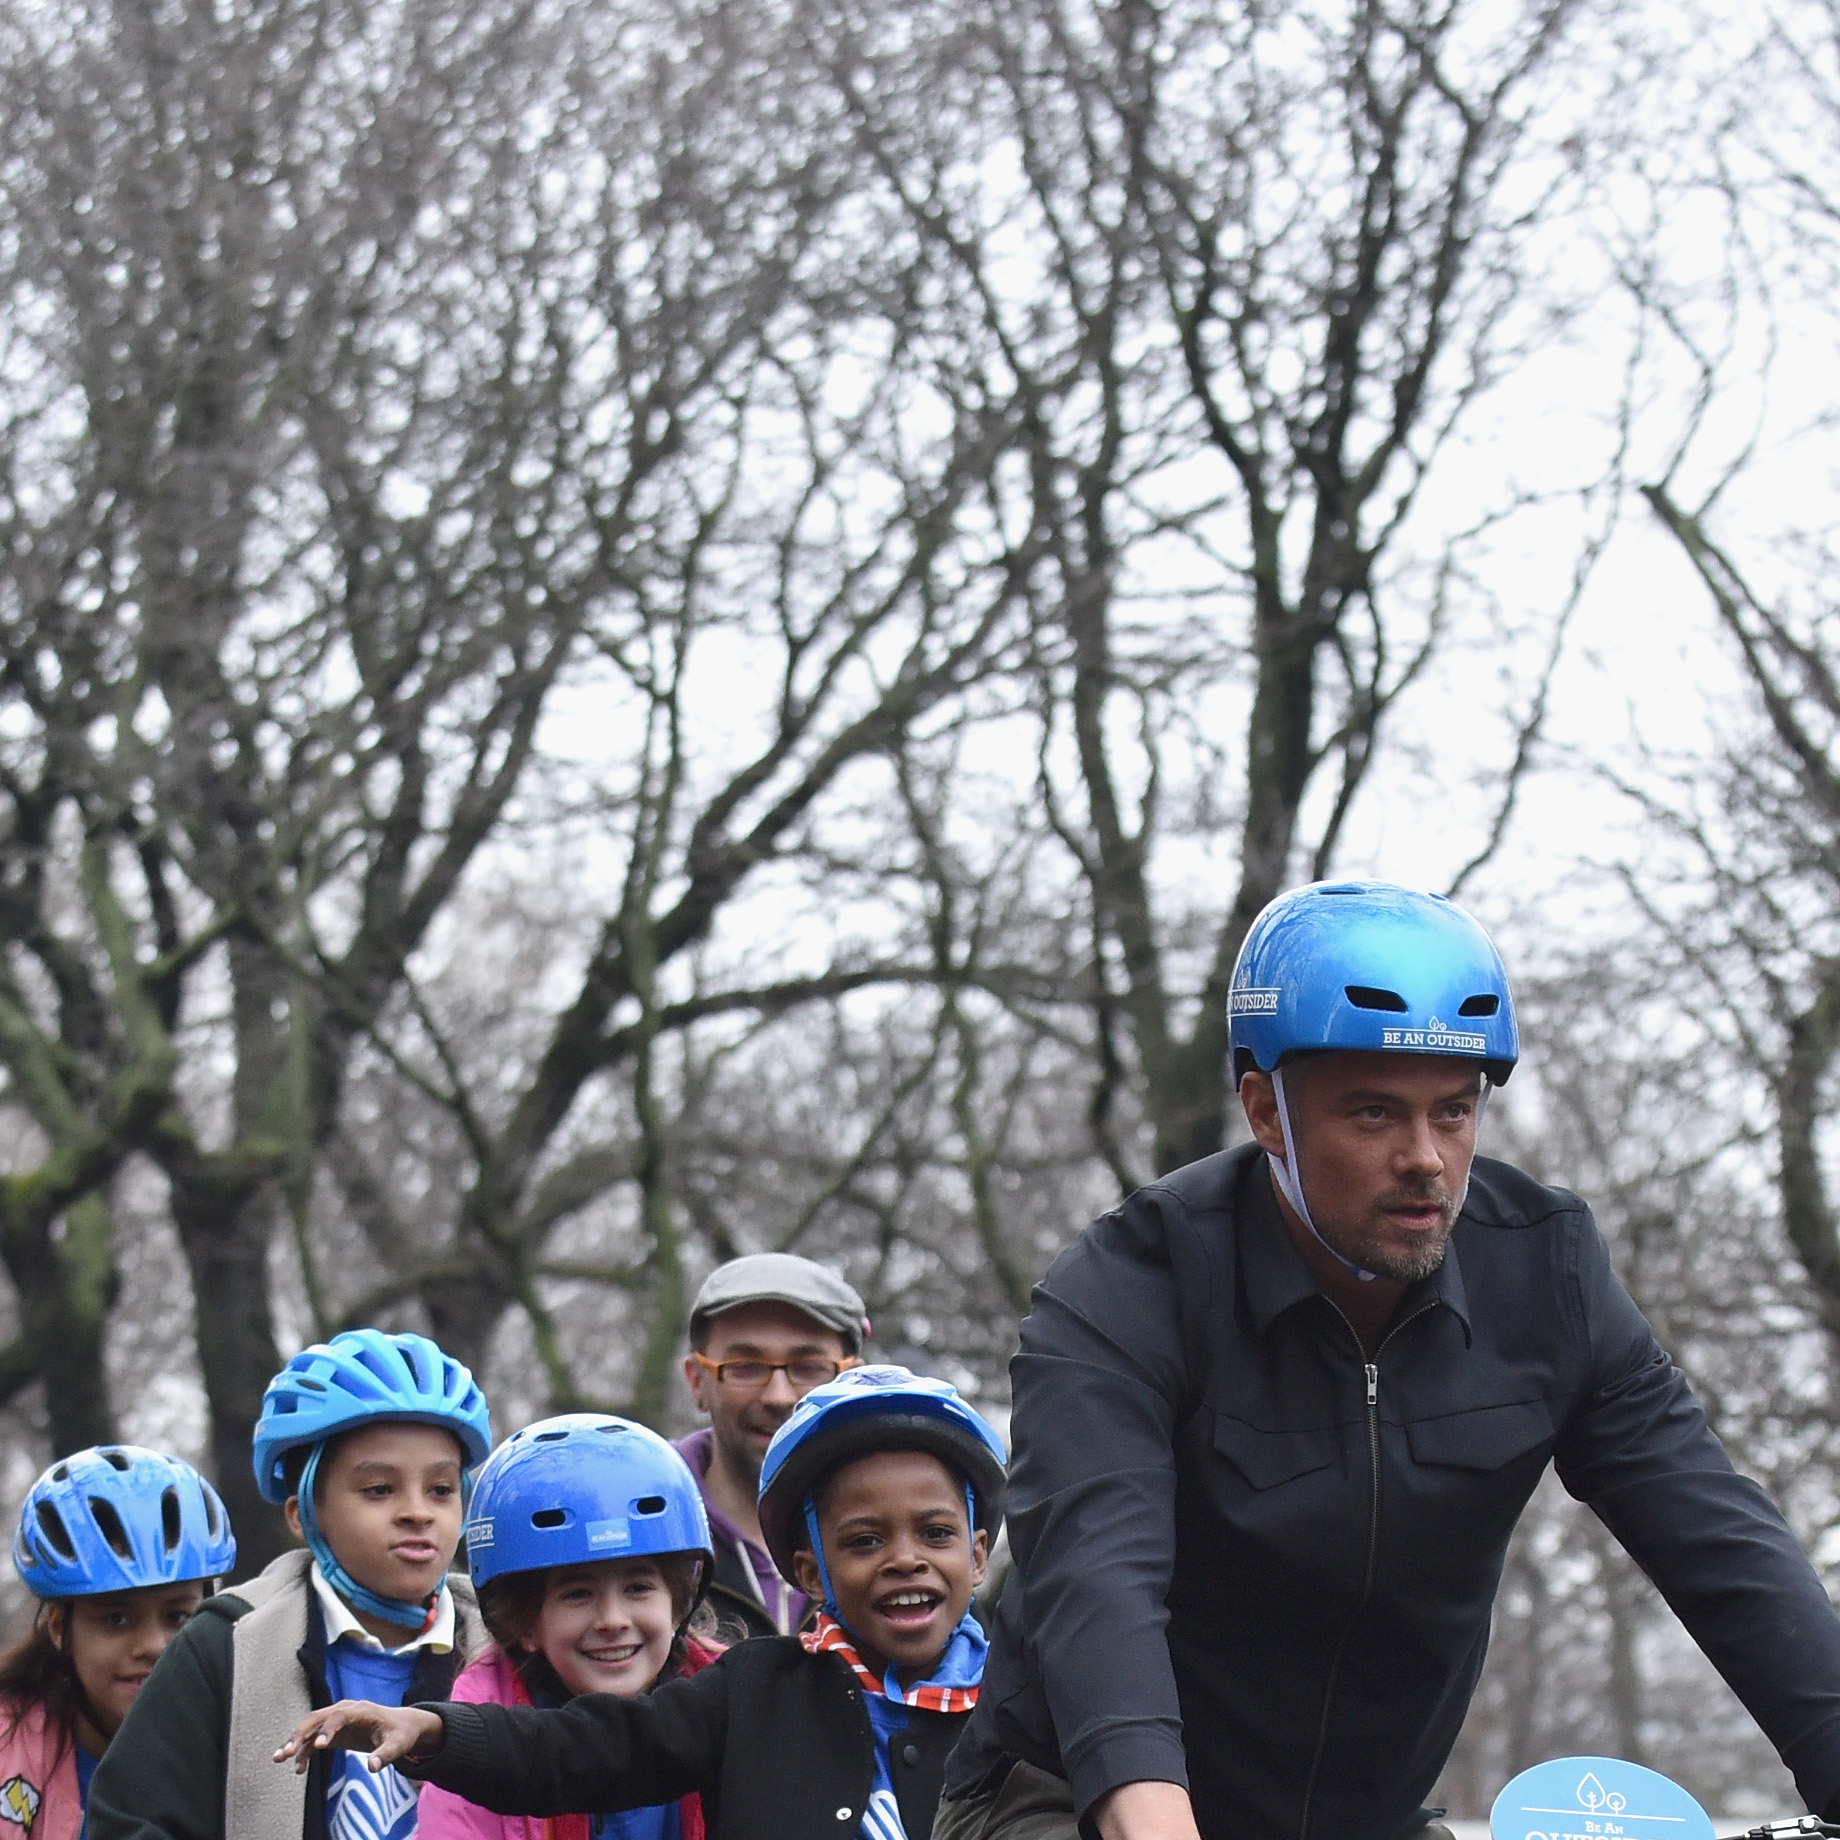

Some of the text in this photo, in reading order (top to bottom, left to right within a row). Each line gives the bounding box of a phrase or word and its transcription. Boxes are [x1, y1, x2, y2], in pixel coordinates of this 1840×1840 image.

[1233, 993, 1279, 1010] OUTSIDER
[1383, 1032, 1486, 1050] BE AN OUTSIDER
